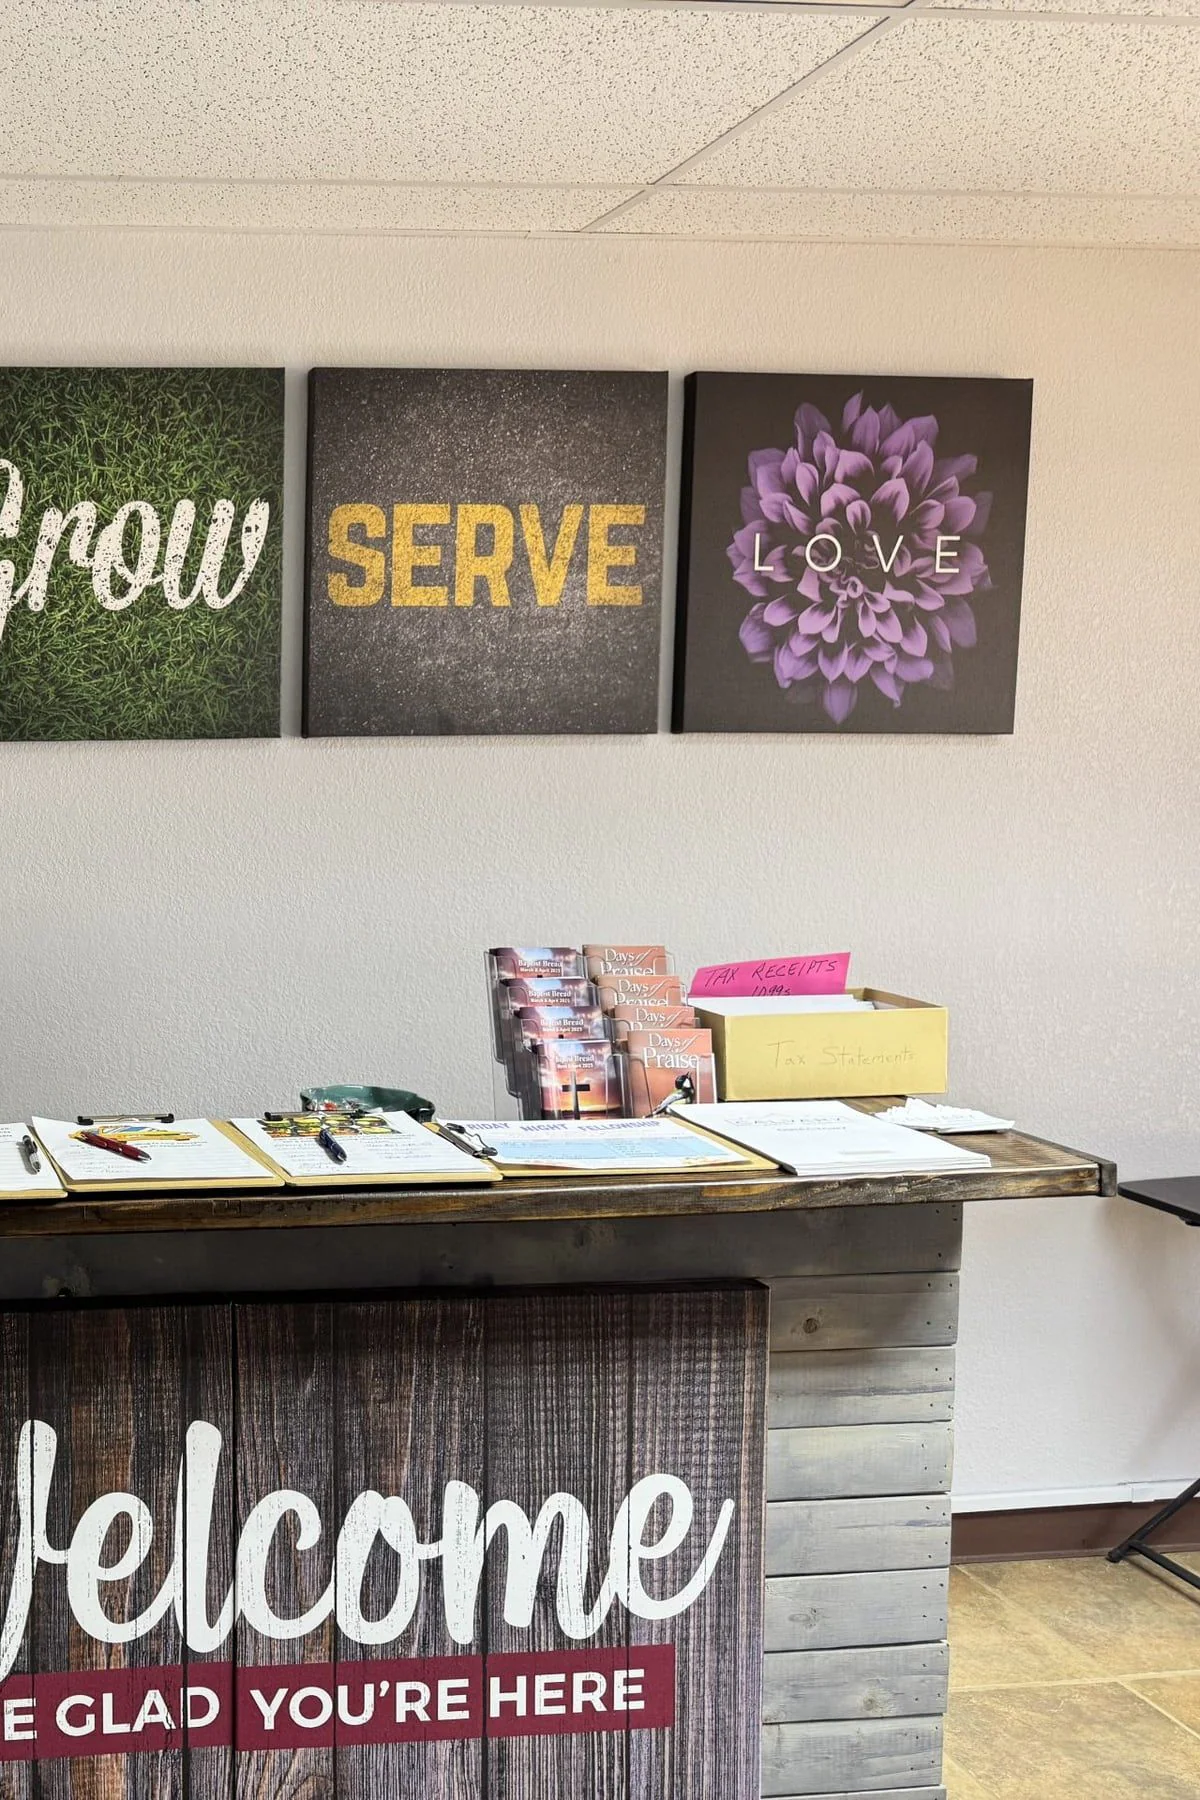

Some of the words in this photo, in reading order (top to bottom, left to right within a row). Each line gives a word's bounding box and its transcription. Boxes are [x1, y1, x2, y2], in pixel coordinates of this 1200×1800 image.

[327, 503, 646, 608] SERVE
[753, 533, 961, 574] LOVE
[605, 948, 634, 964] Days
[705, 967, 739, 987] TAX
[752, 960, 838, 981] RECEIPTS
[618, 979, 649, 996] Days
[563, 1018, 584, 1026] Bread
[636, 1008, 666, 1025] Days
[649, 1032, 680, 1051] Days
[643, 1047, 698, 1068] Praise
[766, 1040, 806, 1069] Tax
[819, 1045, 915, 1067] Statements
[466, 1122, 511, 1131] RIDAY
[519, 1122, 569, 1132] NIGHT
[577, 1120, 661, 1132] FELLOWSHIP
[55, 1686, 221, 1738] GLAD
[250, 1678, 470, 1731] YOU'RE
[489, 1667, 646, 1719] HERE
